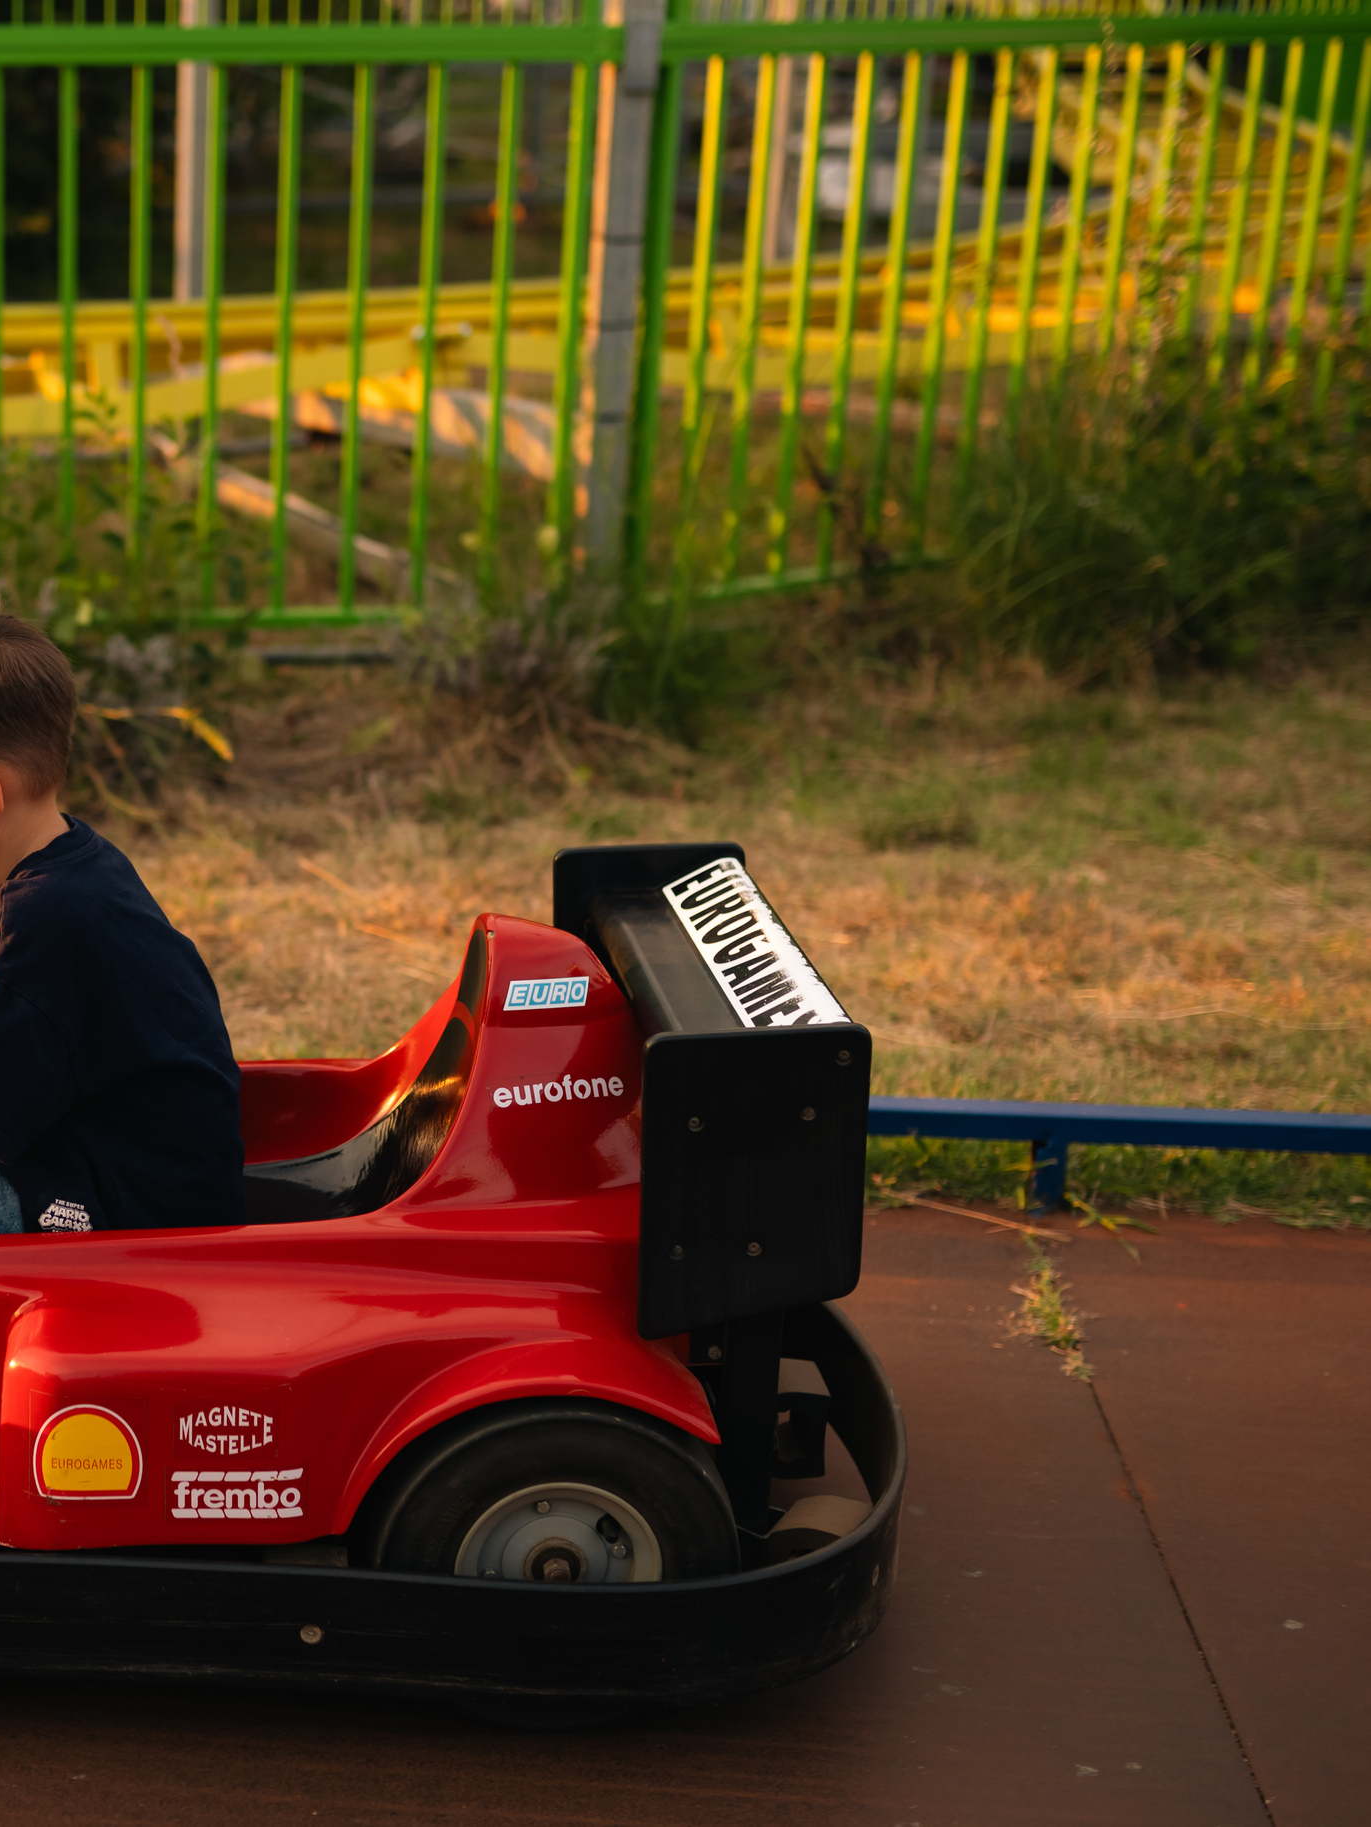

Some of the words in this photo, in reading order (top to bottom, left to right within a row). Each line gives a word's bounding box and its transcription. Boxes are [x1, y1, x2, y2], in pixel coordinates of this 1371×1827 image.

[510, 982, 585, 1005] EURO
[493, 1074, 624, 1108] eurofone
[47, 1204, 90, 1223] MARIO
[55, 1198, 66, 1206] THE
[66, 1201, 85, 1210] SUPER
[38, 1213, 93, 1232] GALAXY
[180, 1406, 273, 1440] MAGNETE
[51, 1457, 123, 1470] EUROGAMES
[174, 1481, 301, 1508] frembo
